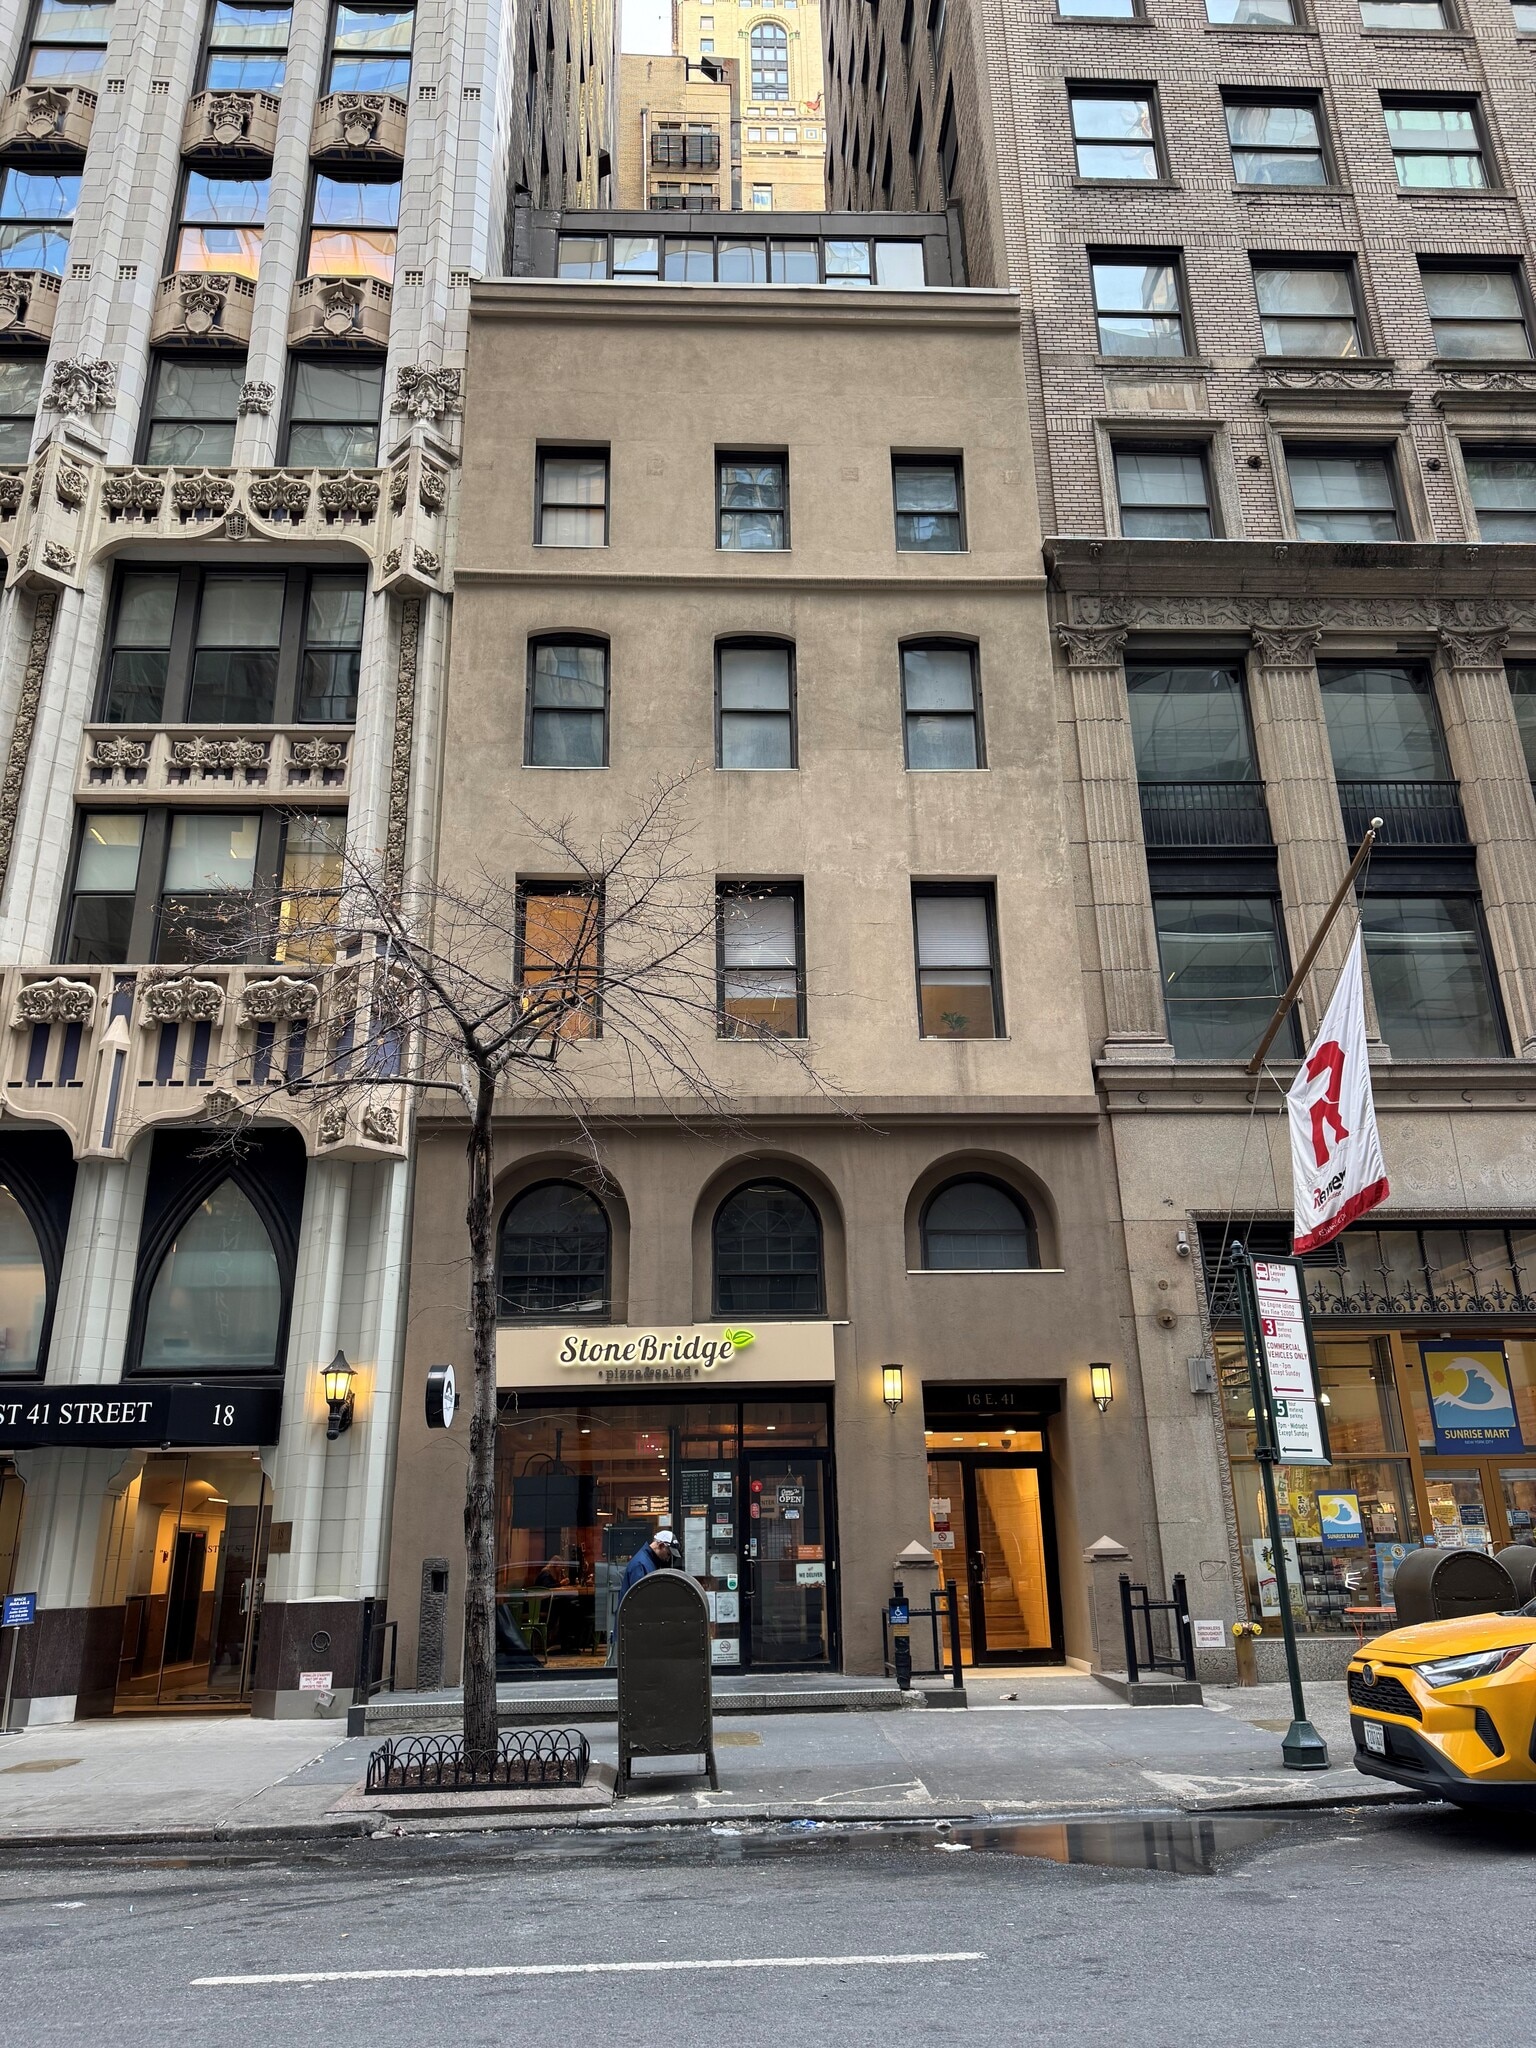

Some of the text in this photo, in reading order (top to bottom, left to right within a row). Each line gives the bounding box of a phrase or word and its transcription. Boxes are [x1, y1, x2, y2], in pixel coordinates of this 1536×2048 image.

[1266, 1320, 1274, 1335] 3
[1266, 1342, 1301, 1351] COMMERCIAL
[1268, 1350, 1308, 1361] VEHICLES ONLY
[1270, 1368, 1285, 1376] Except
[967, 1394, 1014, 1405] 16 E. 41
[26, 1403, 50, 1425] 41
[58, 1402, 153, 1425] STREET
[1276, 1400, 1285, 1416] 5
[212, 1404, 235, 1427] 18
[1290, 1422, 1308, 1430] Midnight
[1279, 1429, 1309, 1438] Except Sunday
[1444, 1429, 1510, 1439] SUNRISE MART
[779, 1495, 802, 1503] OPEN
[1199, 1657, 1229, 1671] 1925
